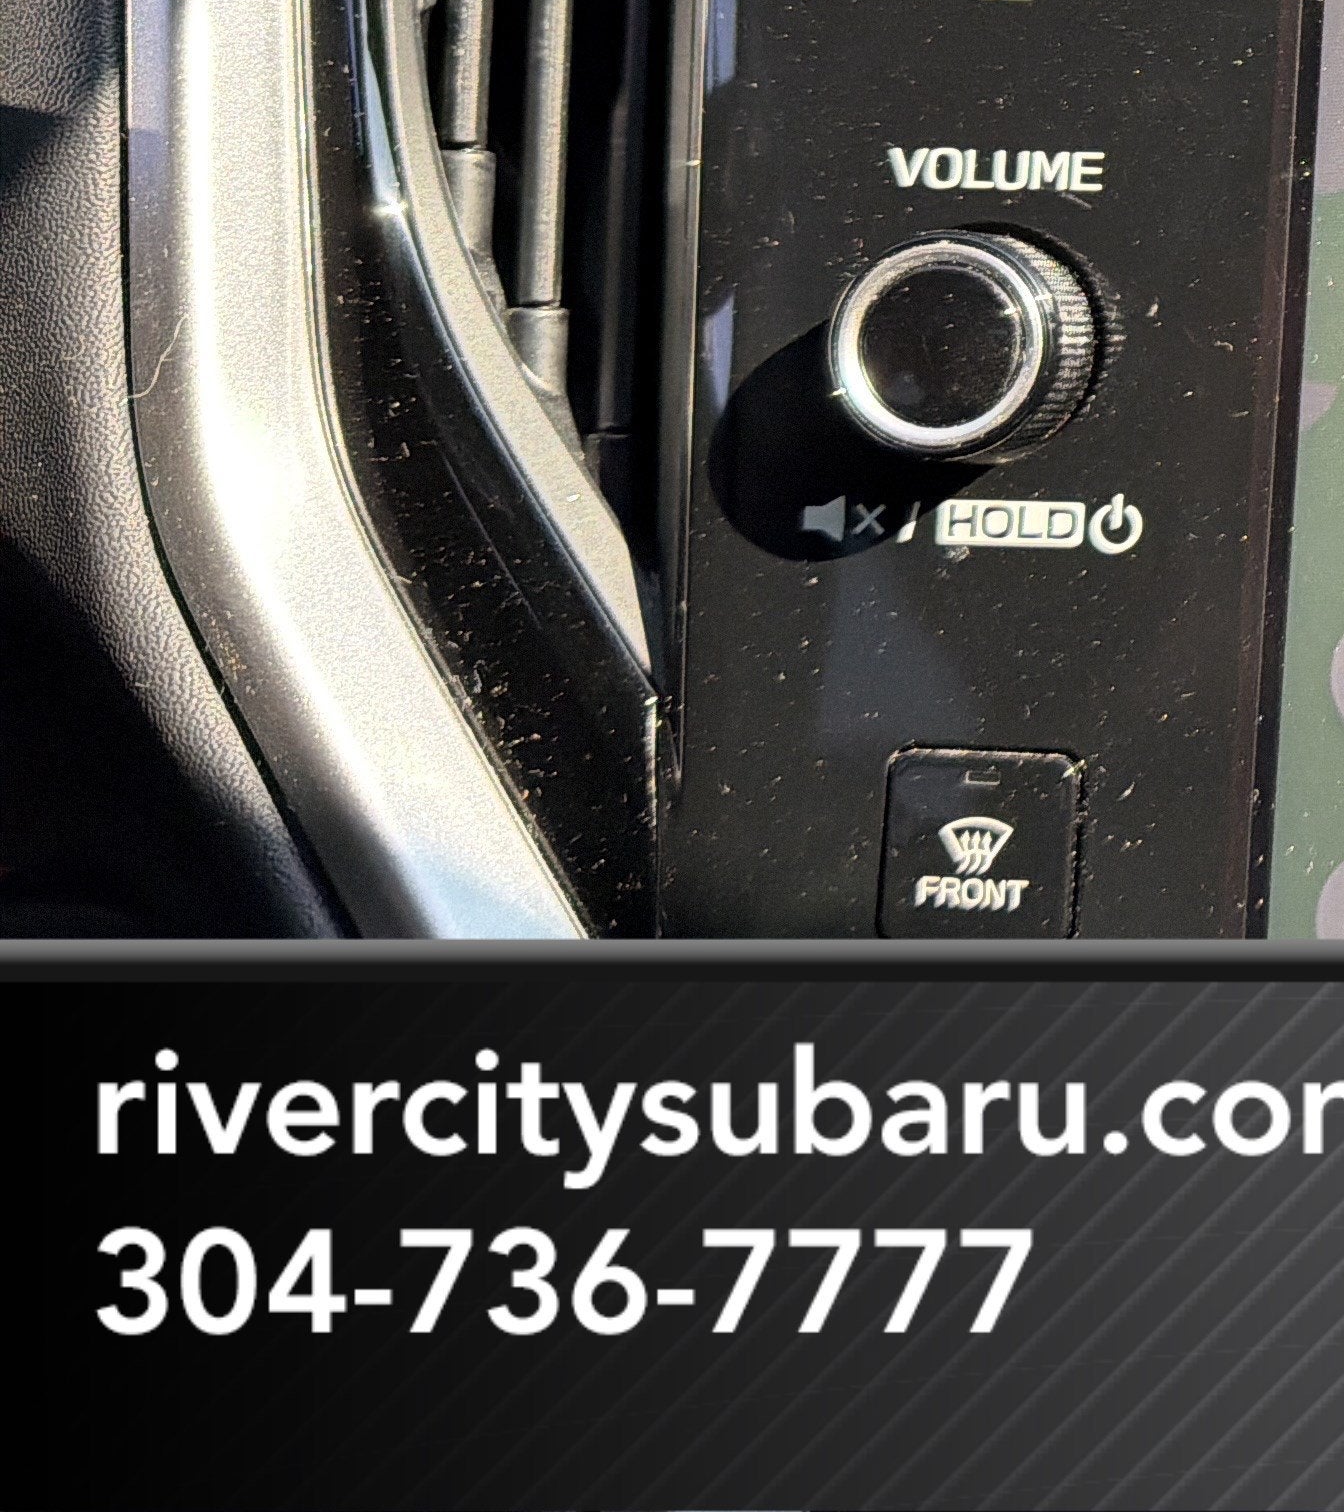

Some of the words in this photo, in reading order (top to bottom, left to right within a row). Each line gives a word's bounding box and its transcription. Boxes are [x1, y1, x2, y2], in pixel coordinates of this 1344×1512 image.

[888, 146, 1106, 191] VOLUME
[944, 503, 1080, 543] HOLD
[914, 875, 1030, 913] FRONT
